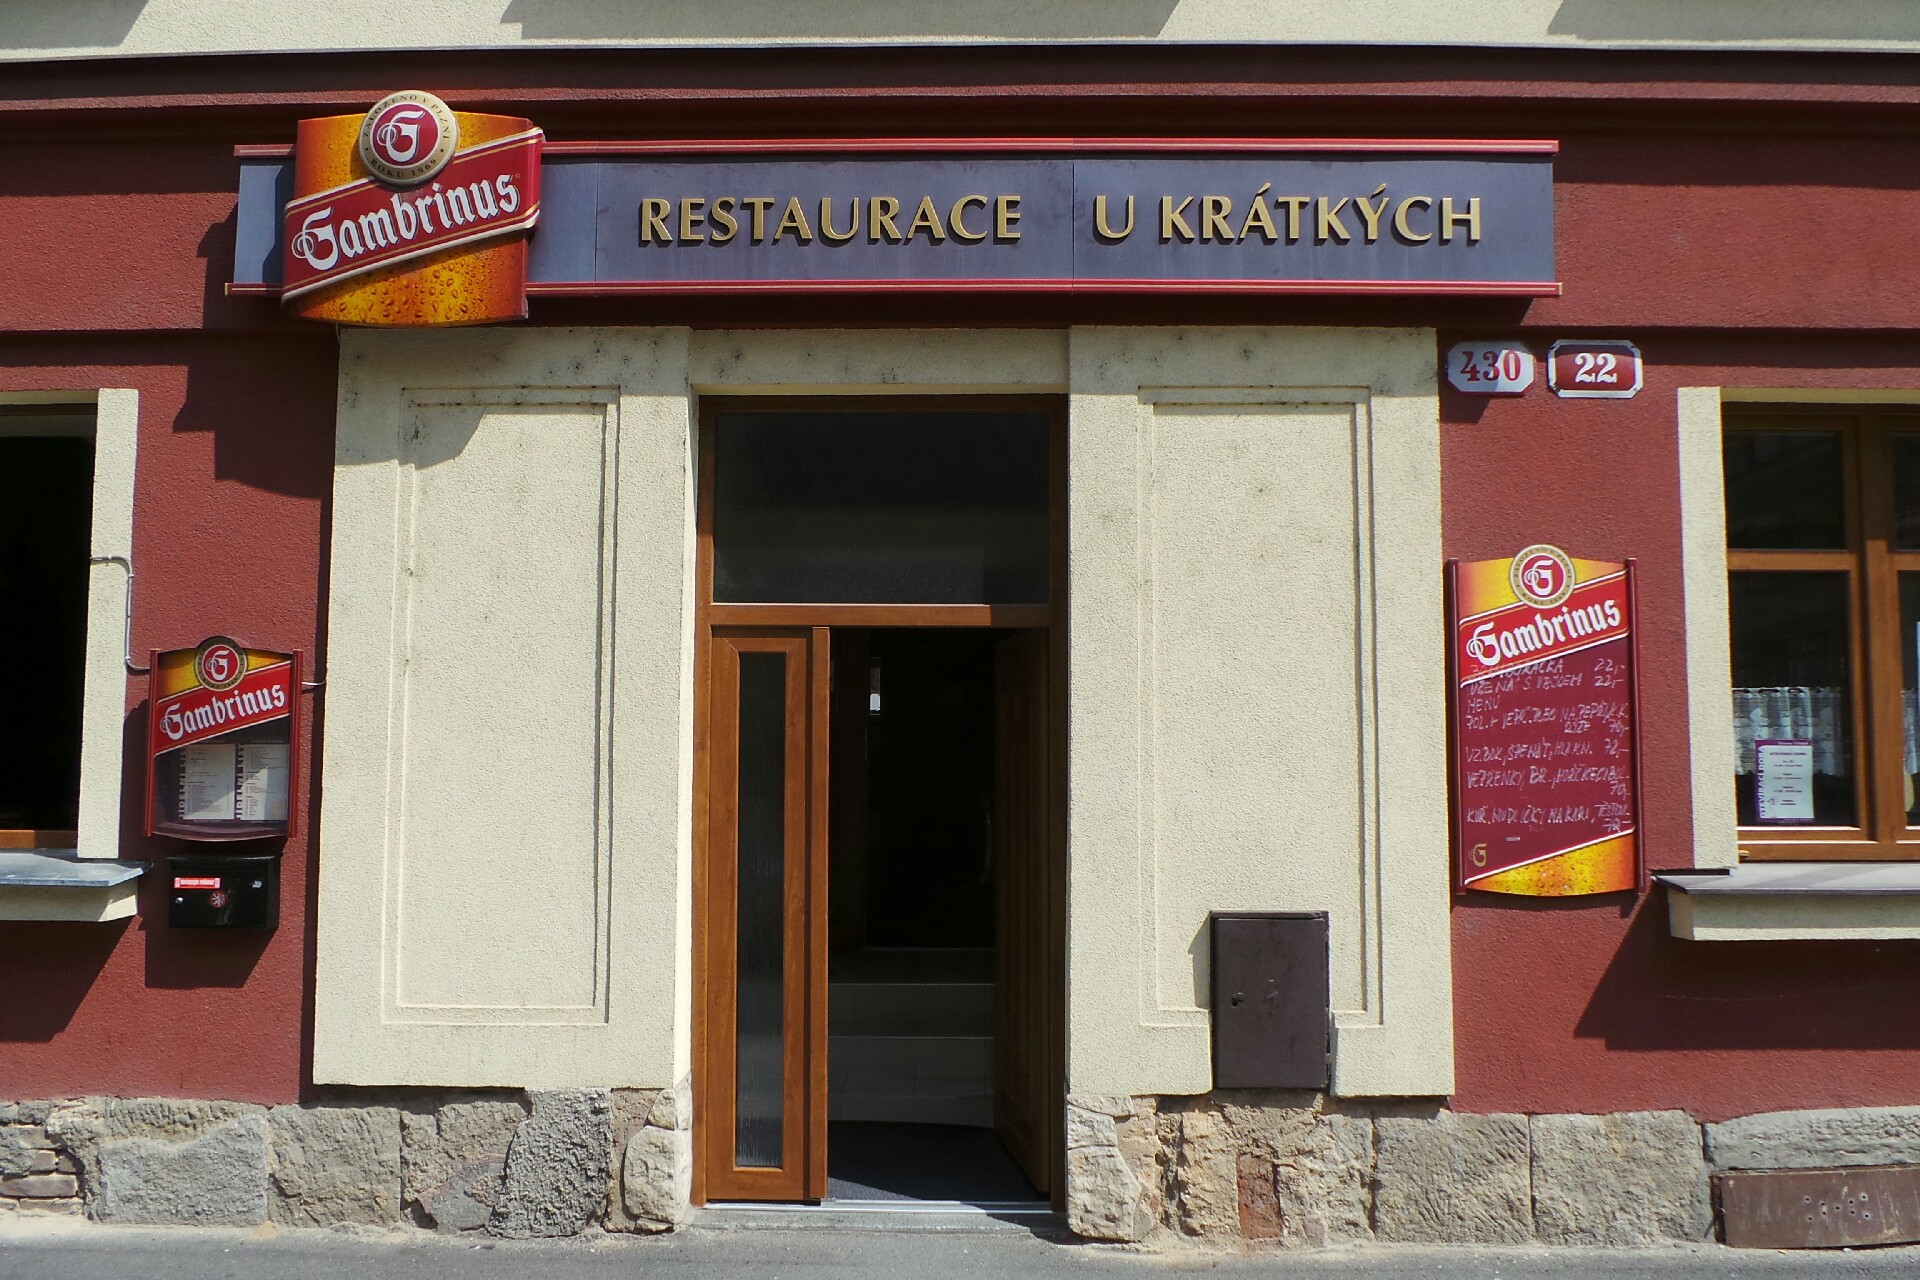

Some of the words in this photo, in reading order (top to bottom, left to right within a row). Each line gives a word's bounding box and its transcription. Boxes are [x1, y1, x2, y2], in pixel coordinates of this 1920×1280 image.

[370, 158, 404, 178] ROKU
[411, 158, 437, 176] 1869
[291, 173, 520, 271] Gambrinus
[640, 195, 1022, 242] RESTAURACE
[1093, 194, 1135, 241] U
[1161, 182, 1481, 242] KRÁTKÝCH
[1460, 350, 1522, 382] 430
[1574, 352, 1618, 384] 22
[1466, 599, 1621, 666] Gambrinus
[160, 683, 286, 741] Gambrinus
